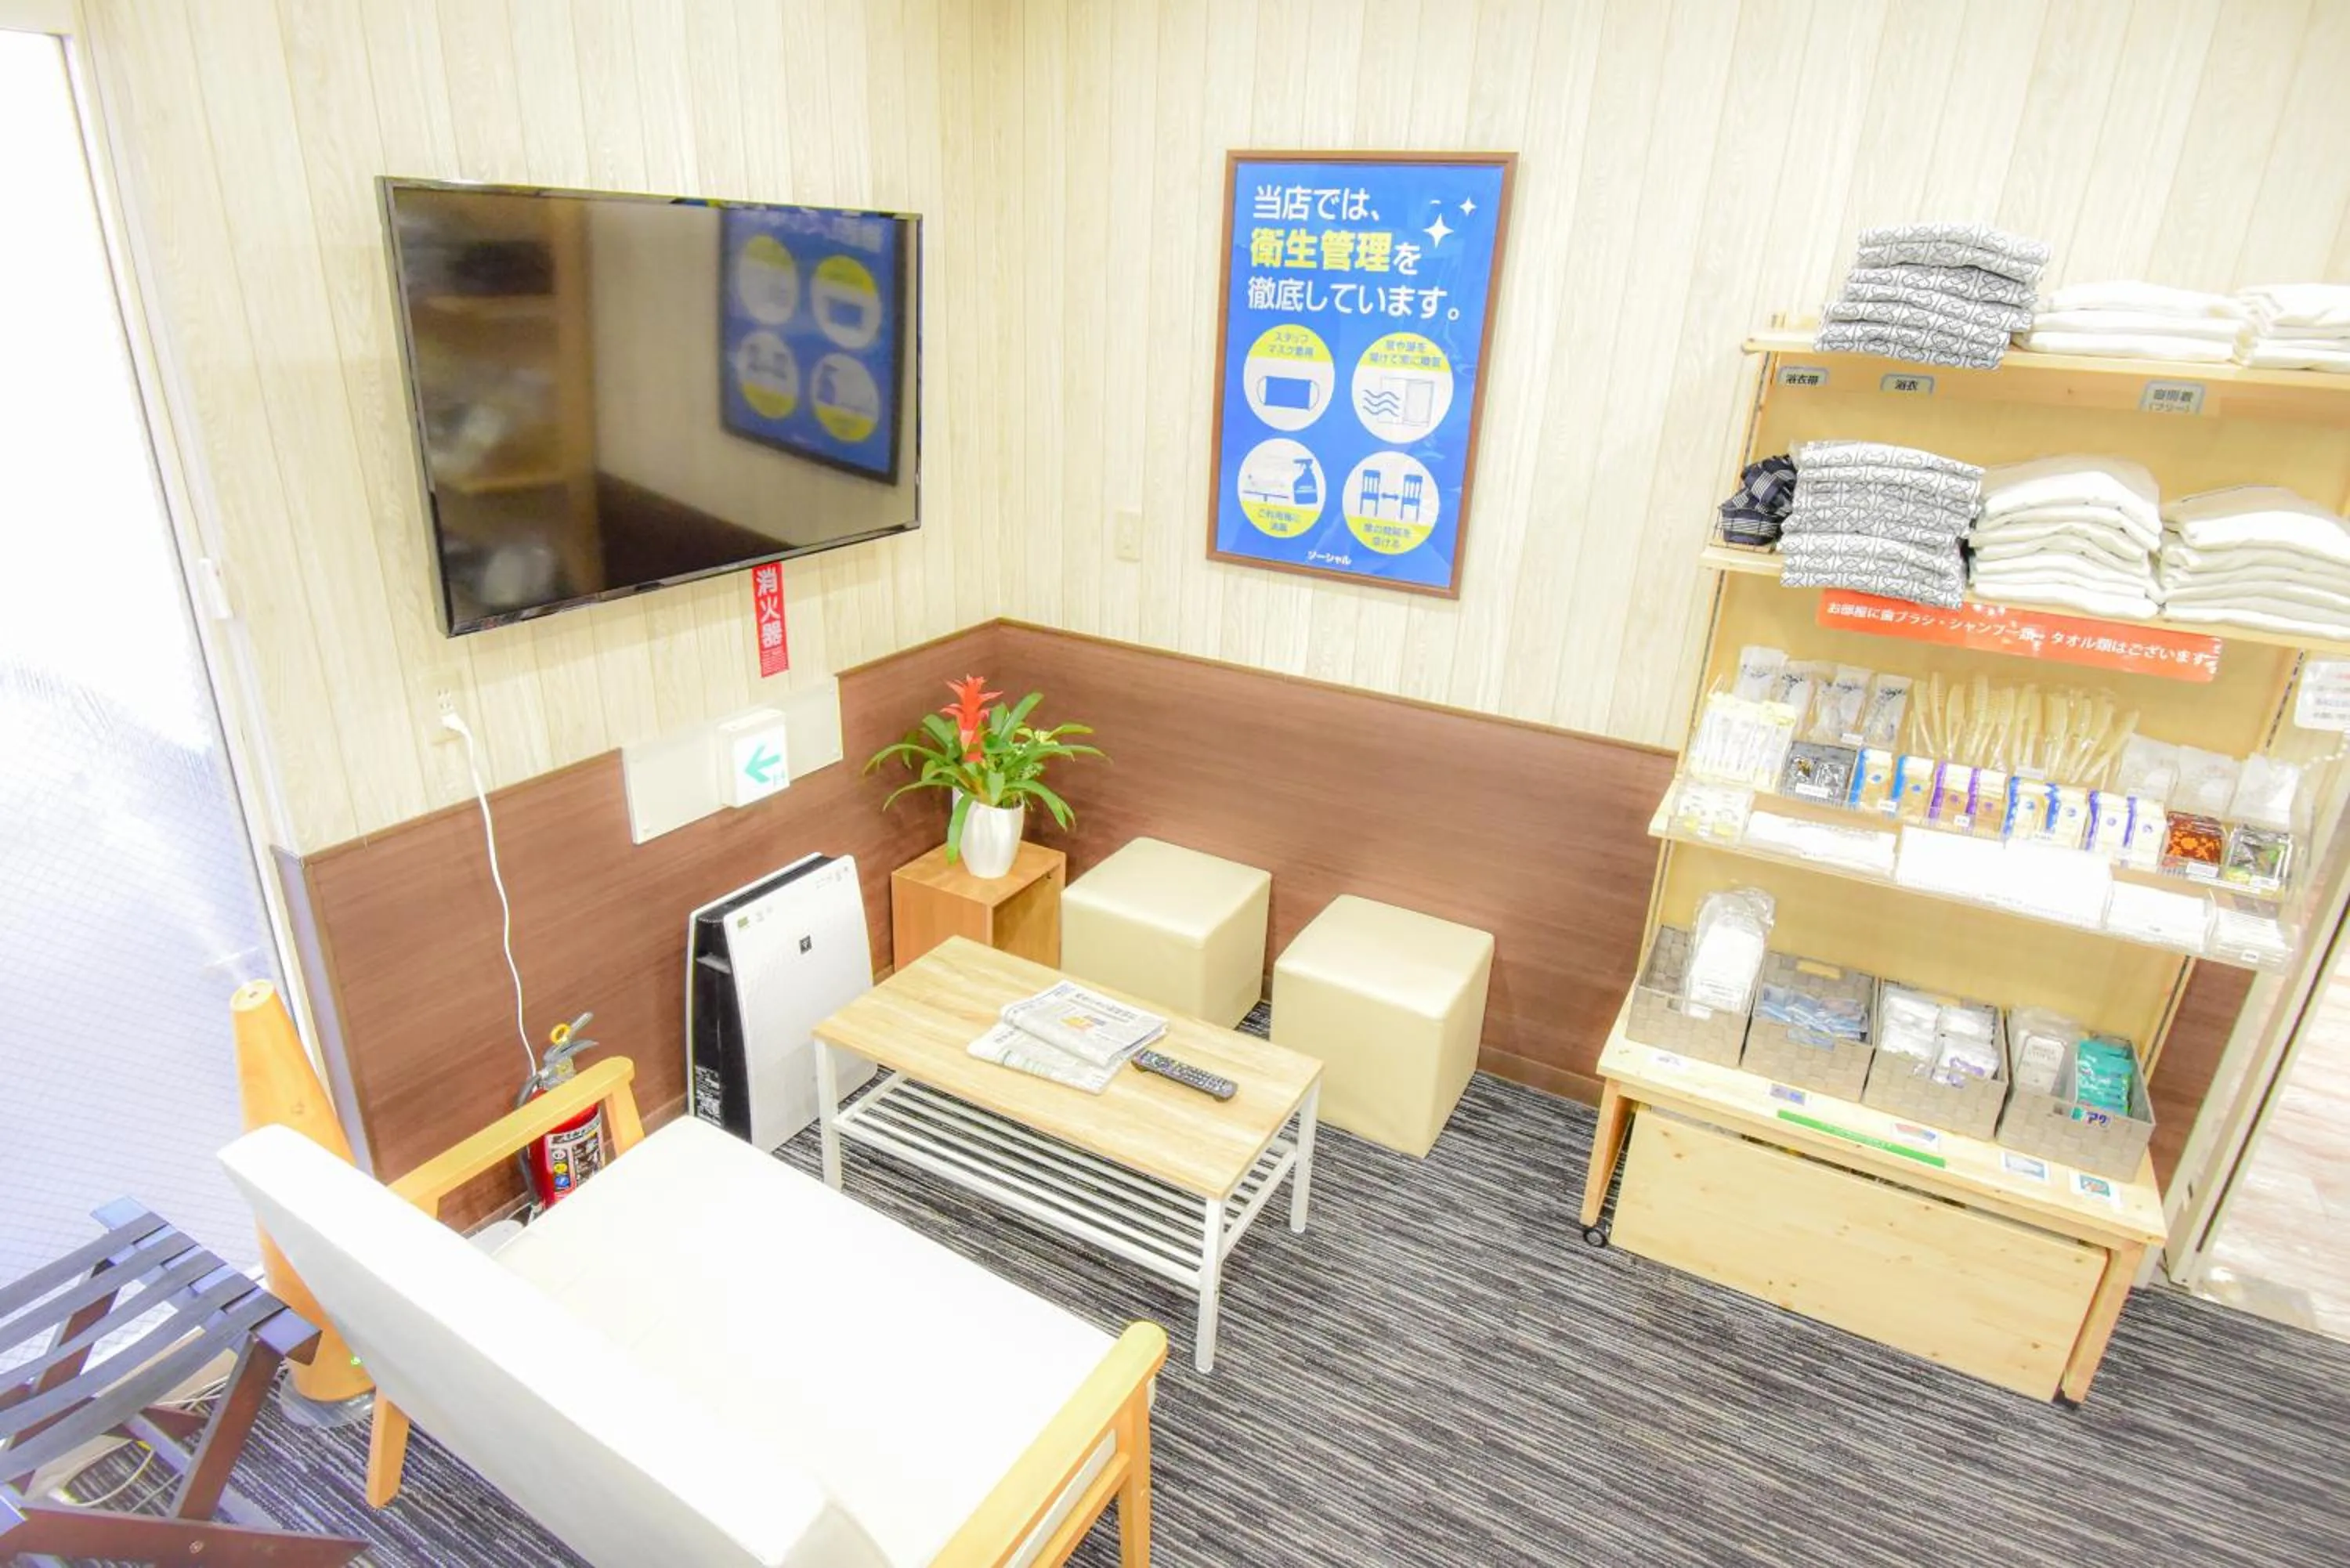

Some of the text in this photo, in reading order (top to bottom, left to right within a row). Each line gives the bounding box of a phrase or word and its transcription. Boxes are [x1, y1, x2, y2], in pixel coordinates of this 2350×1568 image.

[1253, 184, 1379, 222] 当店では、
[1249, 227, 1422, 275] 衛生管理を
[1247, 276, 1460, 320] 徹底しています。
[757, 565, 783, 649] 消火器
